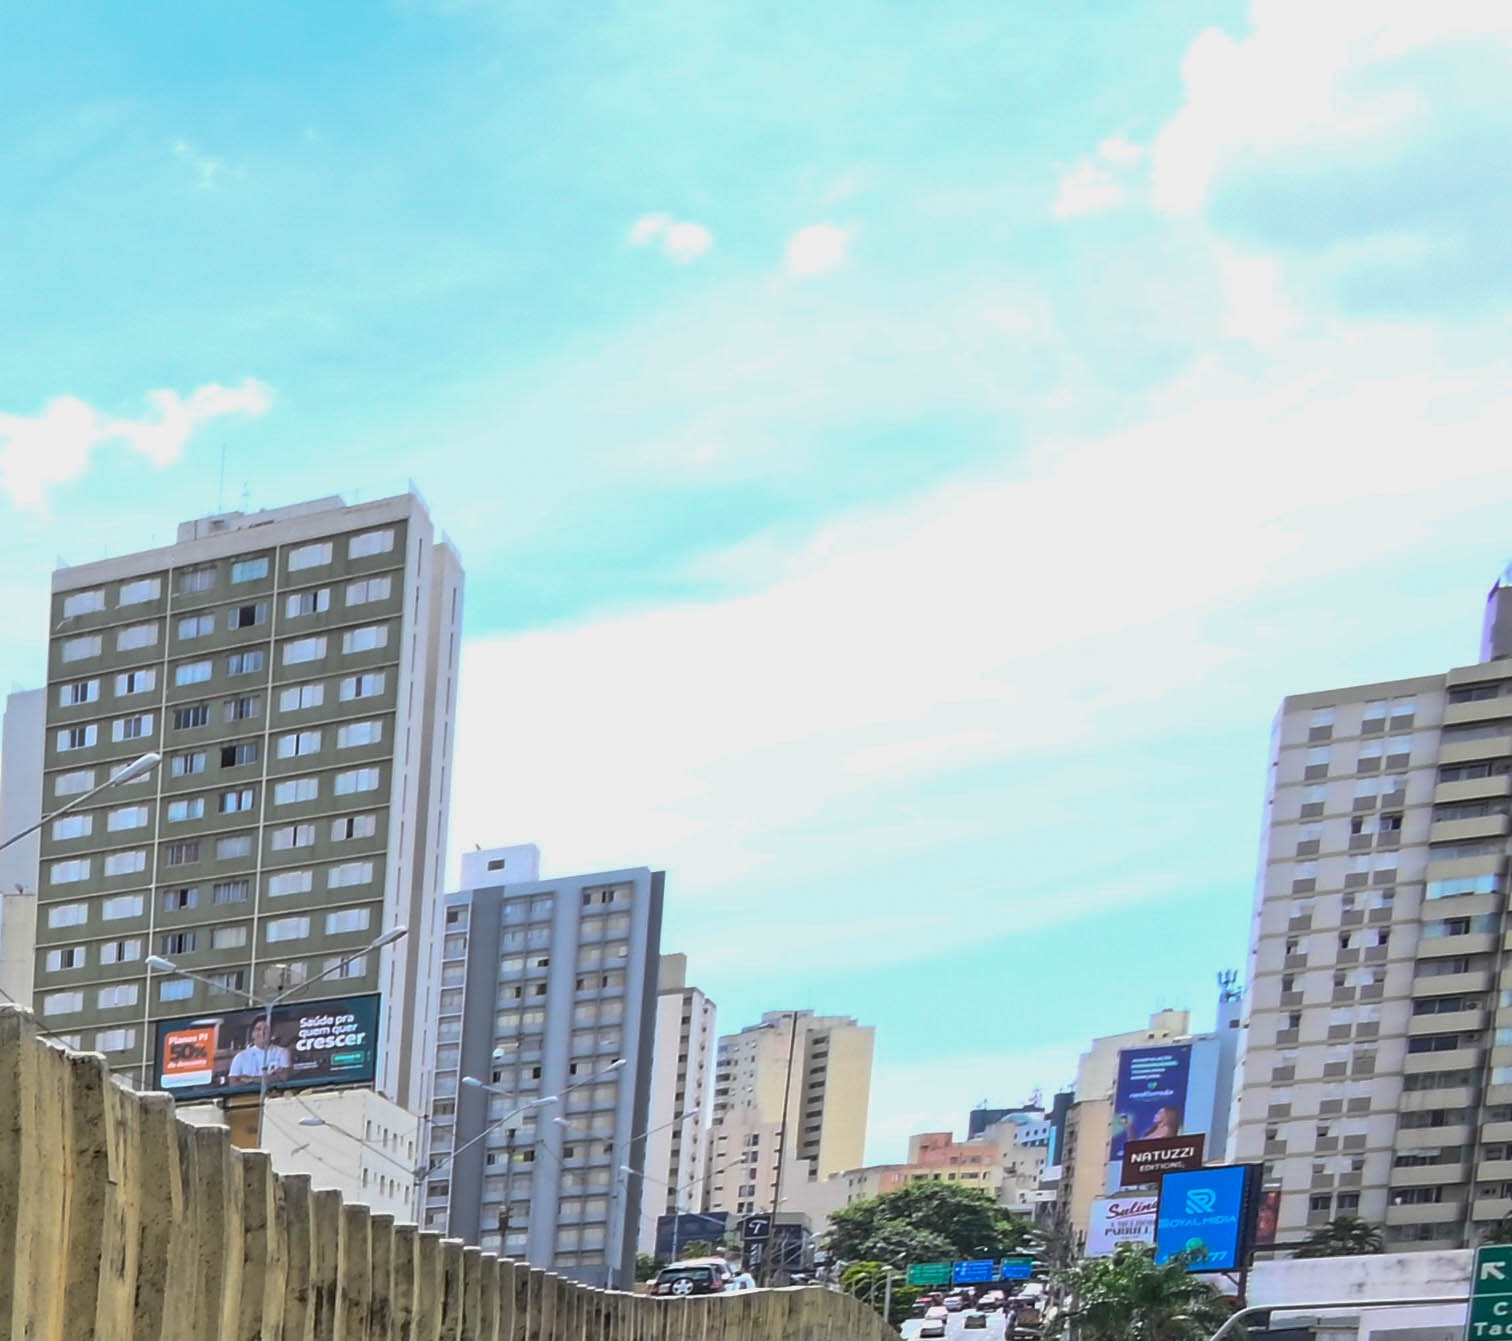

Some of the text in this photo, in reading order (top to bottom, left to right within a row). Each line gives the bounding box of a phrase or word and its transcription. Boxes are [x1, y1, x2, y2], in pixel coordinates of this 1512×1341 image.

[296, 1032, 366, 1051] crescer
[1131, 1147, 1195, 1164] NATUZZI
[1159, 1217, 1201, 1229] OYAL
[1493, 1301, 1512, 1317] C
